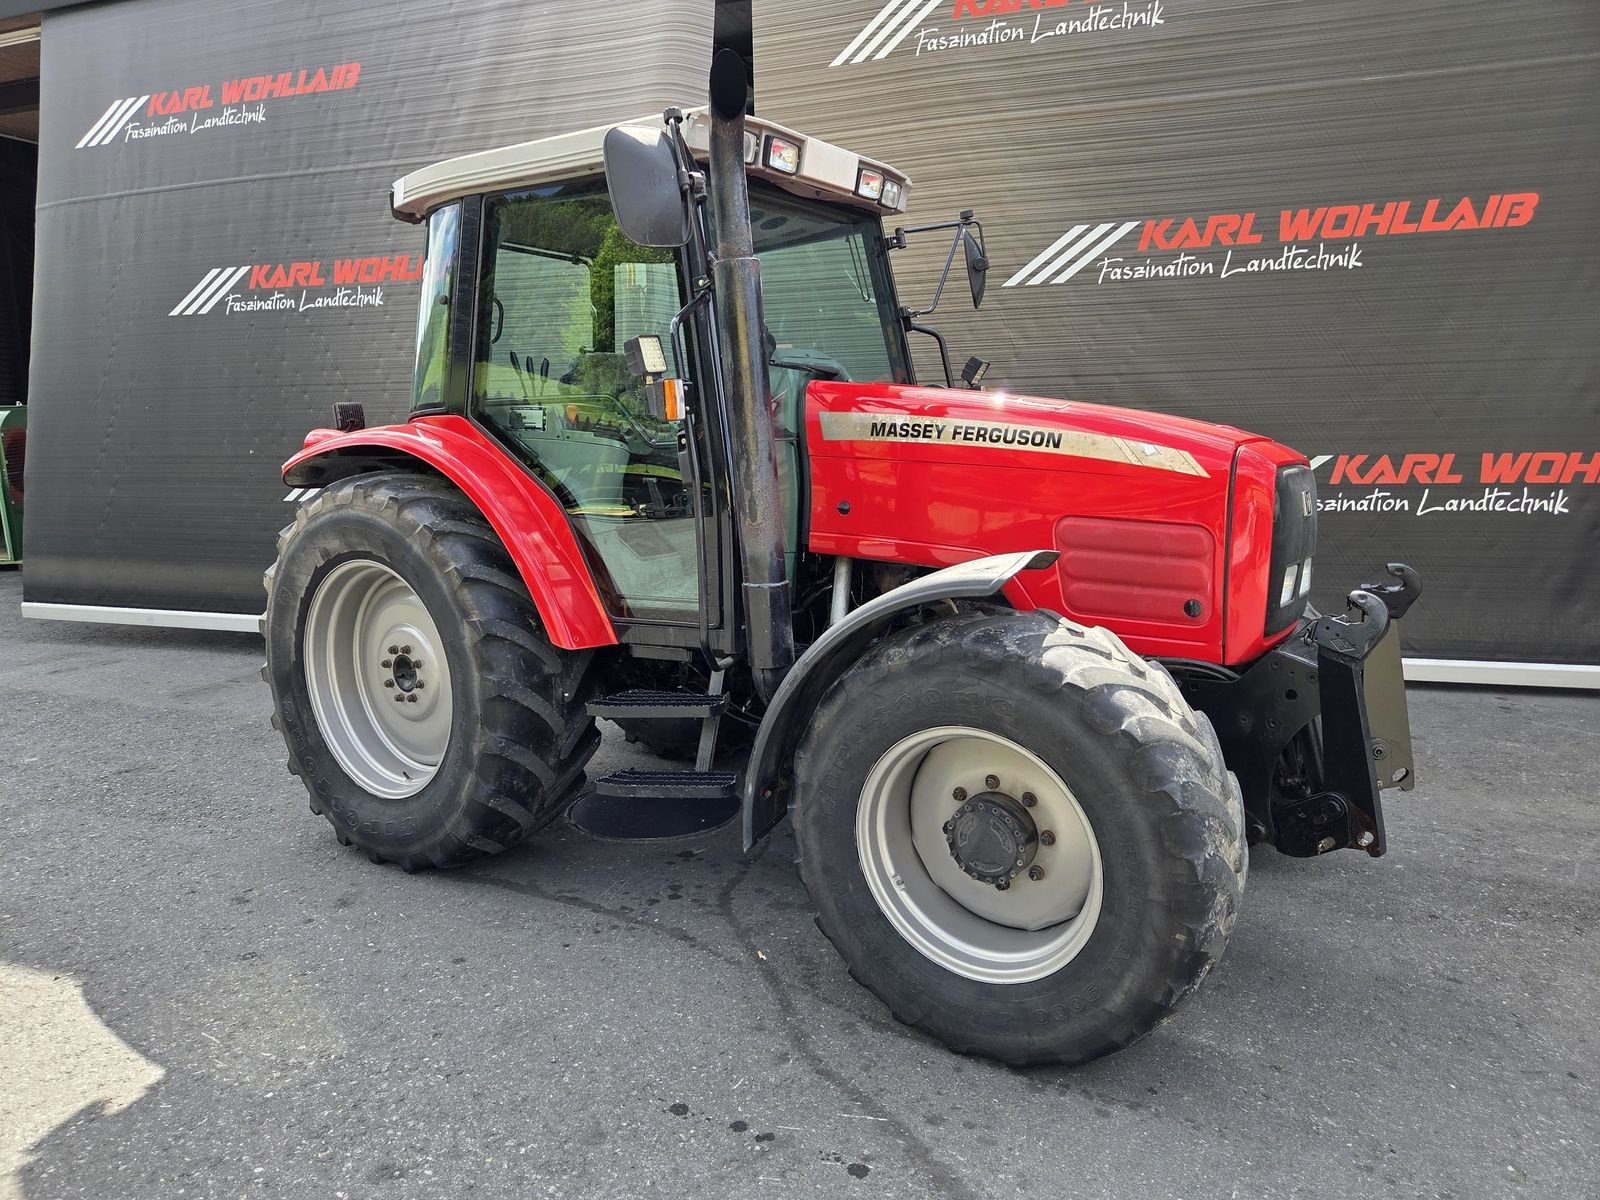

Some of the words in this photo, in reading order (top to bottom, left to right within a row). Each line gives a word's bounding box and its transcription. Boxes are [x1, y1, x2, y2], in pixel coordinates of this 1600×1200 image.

[915, 19, 1024, 56] Faszination
[1031, 1, 1165, 43] Landtechnik
[147, 85, 214, 116] KARL
[124, 115, 187, 143] Faszination
[190, 104, 266, 134] Landtechnik
[1137, 212, 1263, 252] KARL
[249, 261, 325, 289] KARL
[1096, 252, 1214, 285] Faszination
[1220, 242, 1363, 279] Landtechnik
[225, 290, 295, 316] Faszination
[299, 285, 384, 312] Landtechnik
[870, 422, 947, 439] MASSEY
[952, 425, 1063, 449] FERGUSON
[1329, 453, 1464, 485] KARL
[1316, 487, 1410, 513] szination
[1416, 487, 1570, 516] Landtechnik
